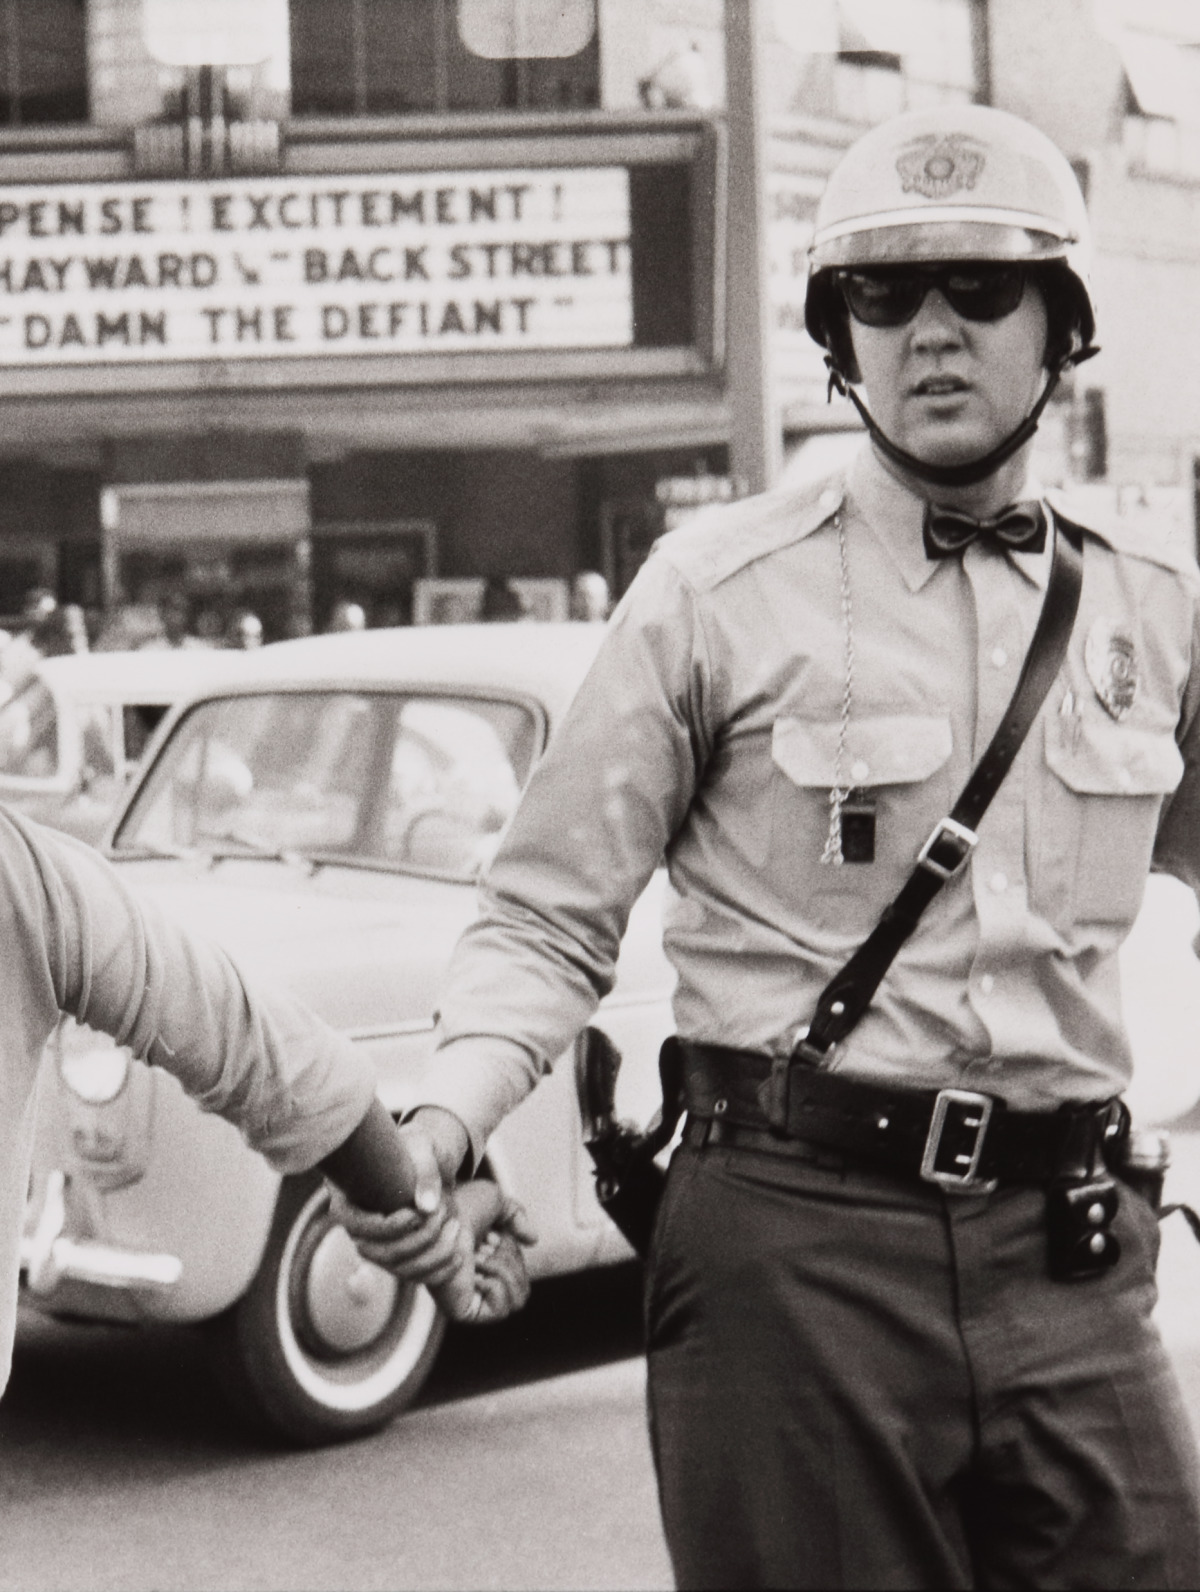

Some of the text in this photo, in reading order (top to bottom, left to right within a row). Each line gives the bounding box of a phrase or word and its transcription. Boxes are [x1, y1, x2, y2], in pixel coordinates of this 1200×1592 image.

[211, 184, 532, 232] EXCITEMENT
[448, 239, 627, 280] STREET
[202, 306, 295, 343] THE
